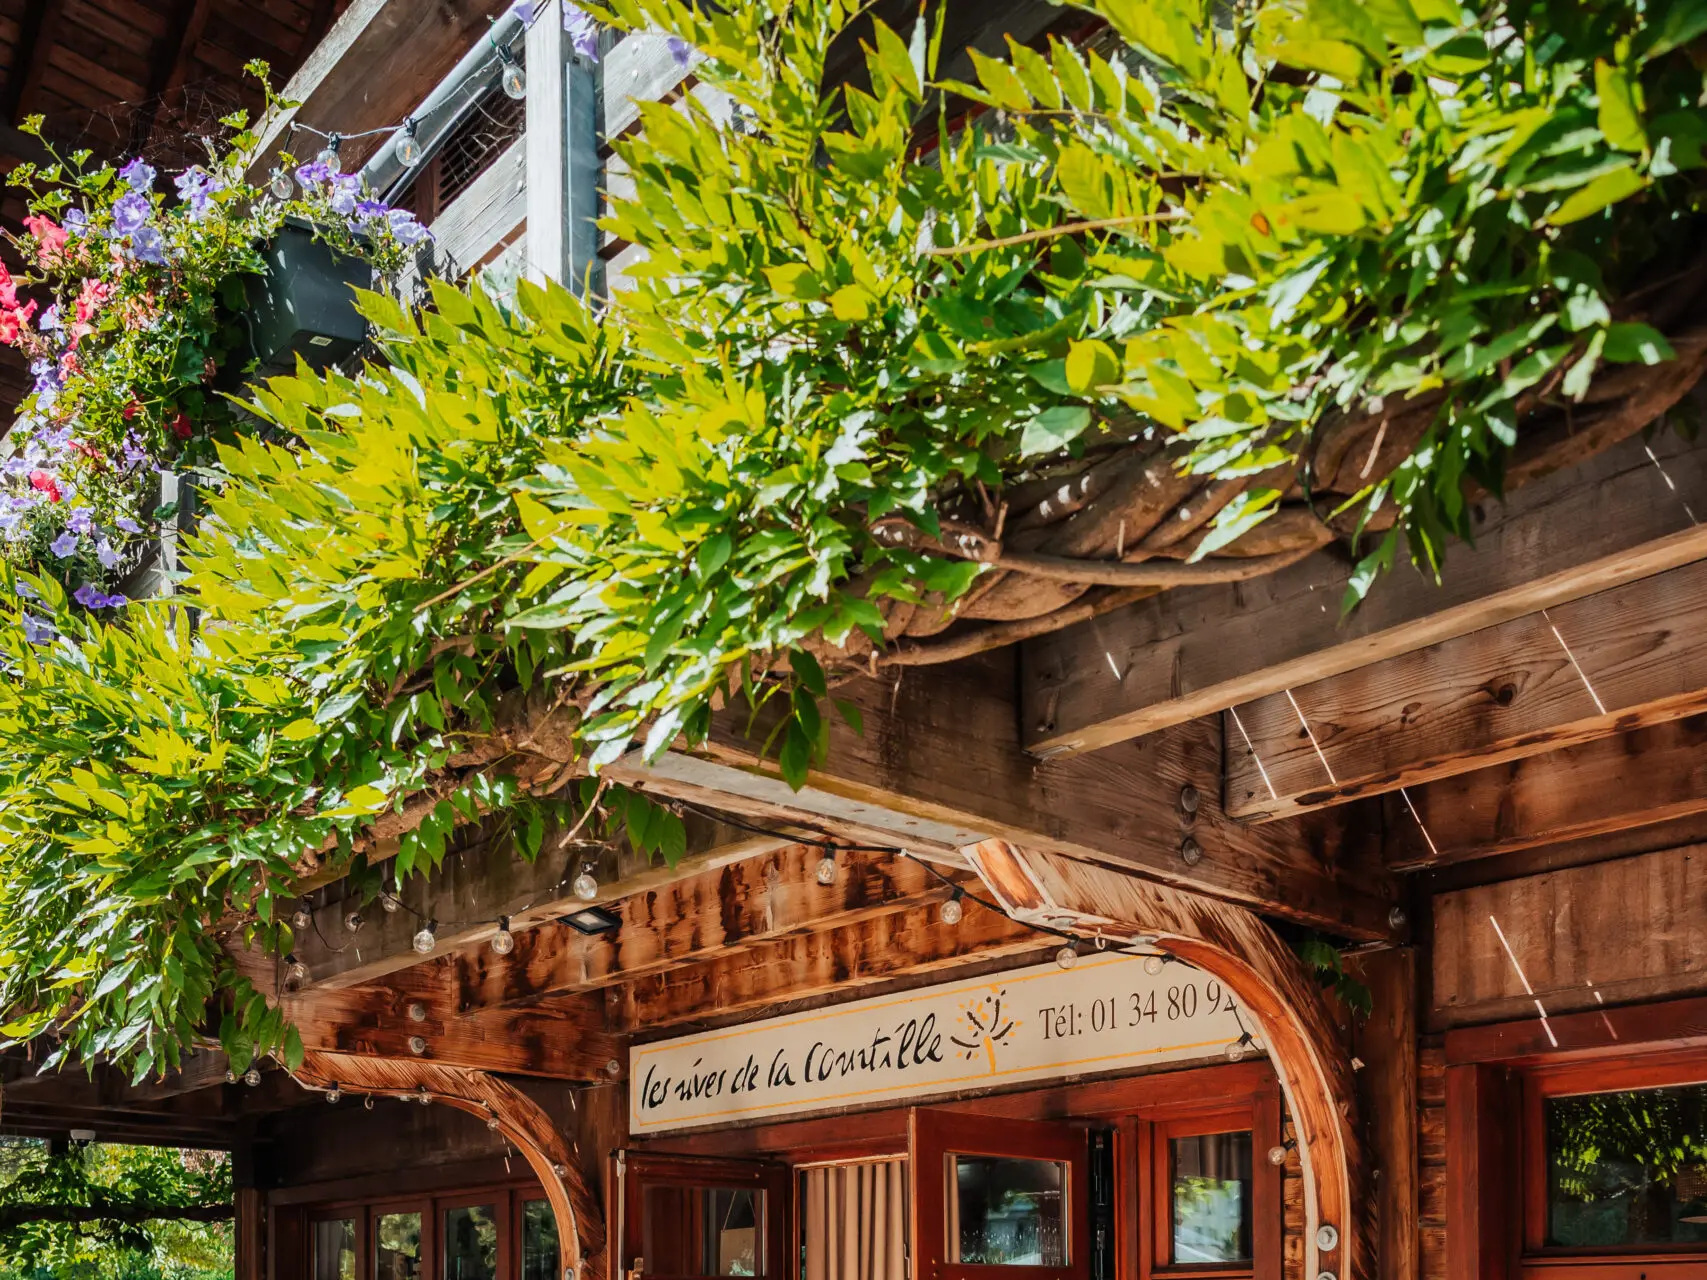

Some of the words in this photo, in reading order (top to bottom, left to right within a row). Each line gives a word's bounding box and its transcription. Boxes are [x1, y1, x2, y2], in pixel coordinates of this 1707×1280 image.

[1038, 1003, 1082, 1040] Tél:
[1091, 998, 1118, 1032] 01
[1128, 990, 1158, 1027] 34
[1167, 983, 1198, 1021] 80
[641, 1064, 671, 1110] les
[675, 1057, 727, 1101] rives
[731, 1054, 759, 1094] de
[767, 1048, 796, 1088] la
[804, 1012, 944, 1083] Courtille
